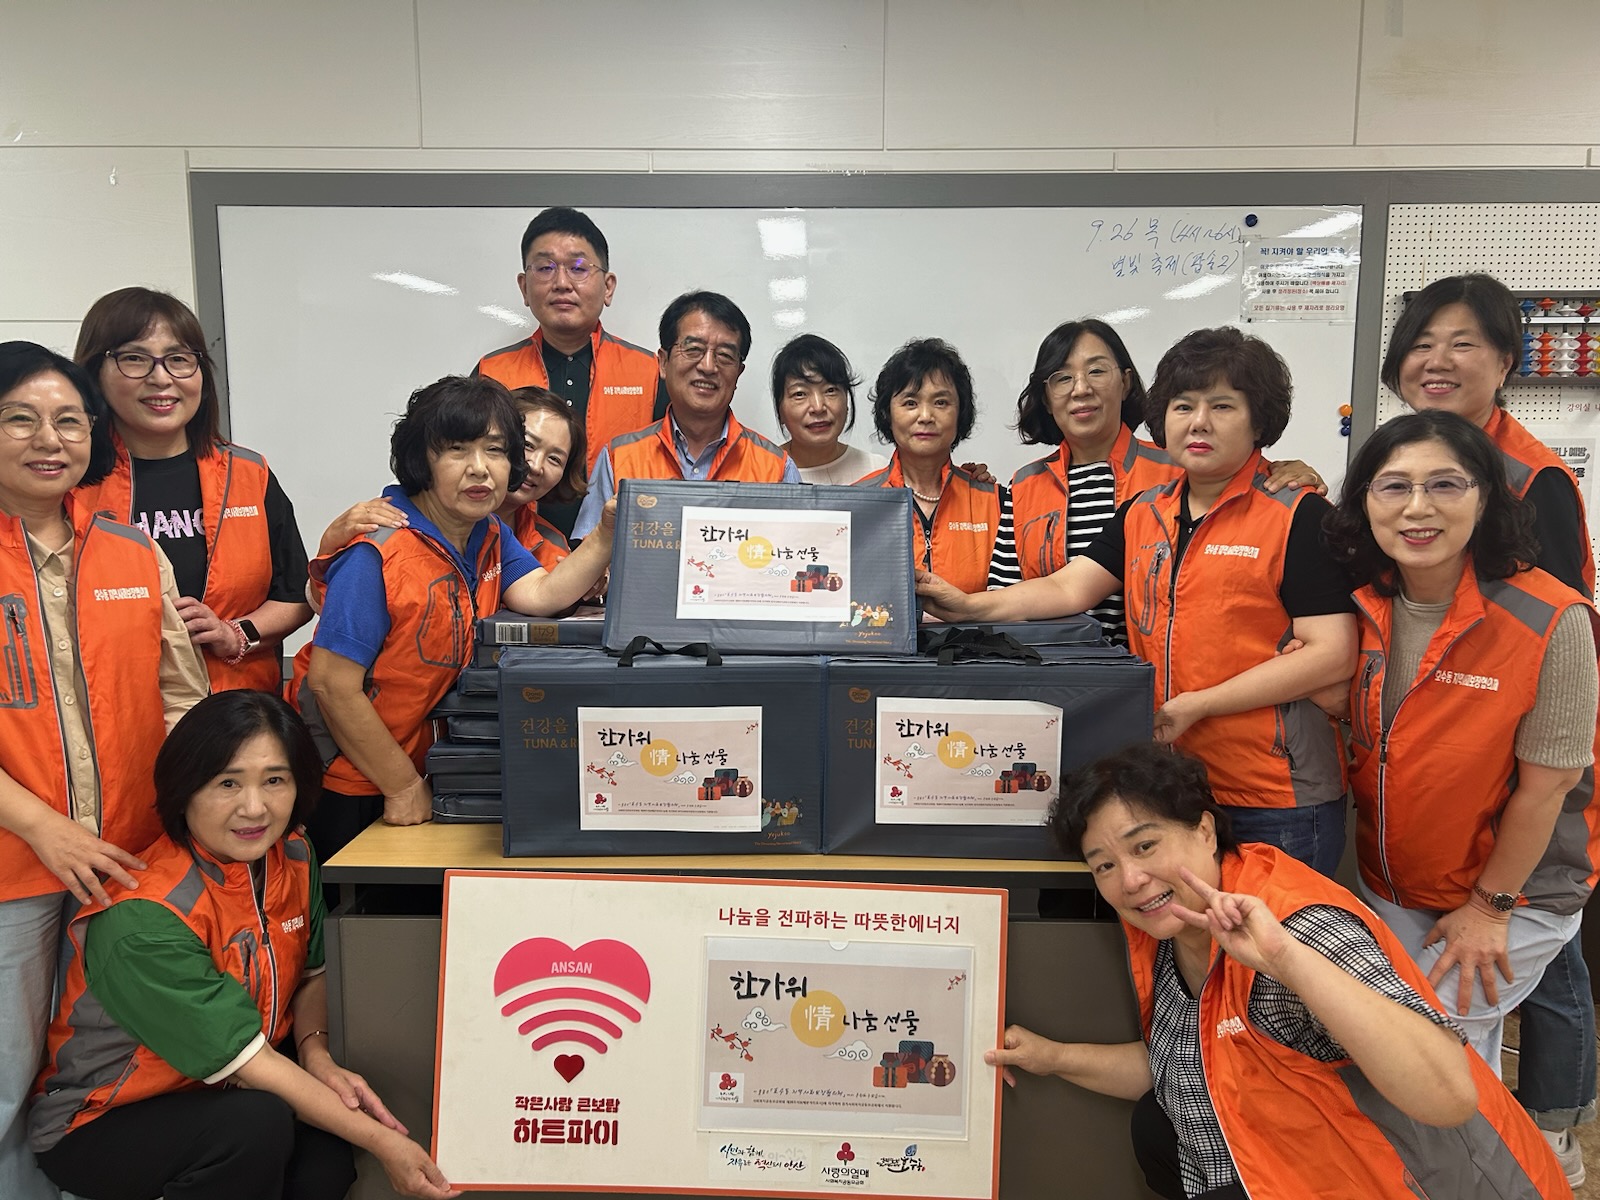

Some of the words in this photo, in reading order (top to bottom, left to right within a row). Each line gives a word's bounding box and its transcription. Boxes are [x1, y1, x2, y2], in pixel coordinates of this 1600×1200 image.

[1271, 247, 1294, 256] 지켜야
[1296, 247, 1304, 256] 할
[1566, 403, 1591, 412] 강의실
[631, 521, 676, 537] 건강을
[700, 527, 749, 543] 한가위
[633, 539, 664, 549] TUNA
[666, 541, 673, 550] &
[746, 544, 766, 561] 情
[771, 548, 793, 561] 나눔
[797, 547, 820, 562] 선물
[520, 716, 569, 735] 건강을
[896, 719, 949, 739] 한가위
[523, 738, 557, 749] TUNA
[560, 738, 568, 749] &
[597, 728, 651, 747] 한가위
[650, 748, 671, 767] 情
[676, 750, 700, 765] 나눔
[704, 749, 728, 767] 선물
[947, 740, 969, 759] 情
[973, 743, 998, 758] 나눔
[1002, 742, 1027, 760] 선물
[719, 906, 771, 928] 나눔을
[778, 909, 848, 930] 전파하는
[854, 912, 960, 934] 따뜻한에너지
[550, 960, 593, 975] ANSAN
[730, 970, 808, 1001] 한가위
[804, 1004, 835, 1032] 情
[842, 1009, 878, 1033] 나눔
[883, 1009, 920, 1036] 선물
[515, 1096, 573, 1112] 작은사랑
[577, 1097, 620, 1113] 큰보람
[513, 1117, 618, 1145] 하트파이
[783, 1161, 806, 1172] 안산
[821, 1167, 870, 1180] 사랑의열매
